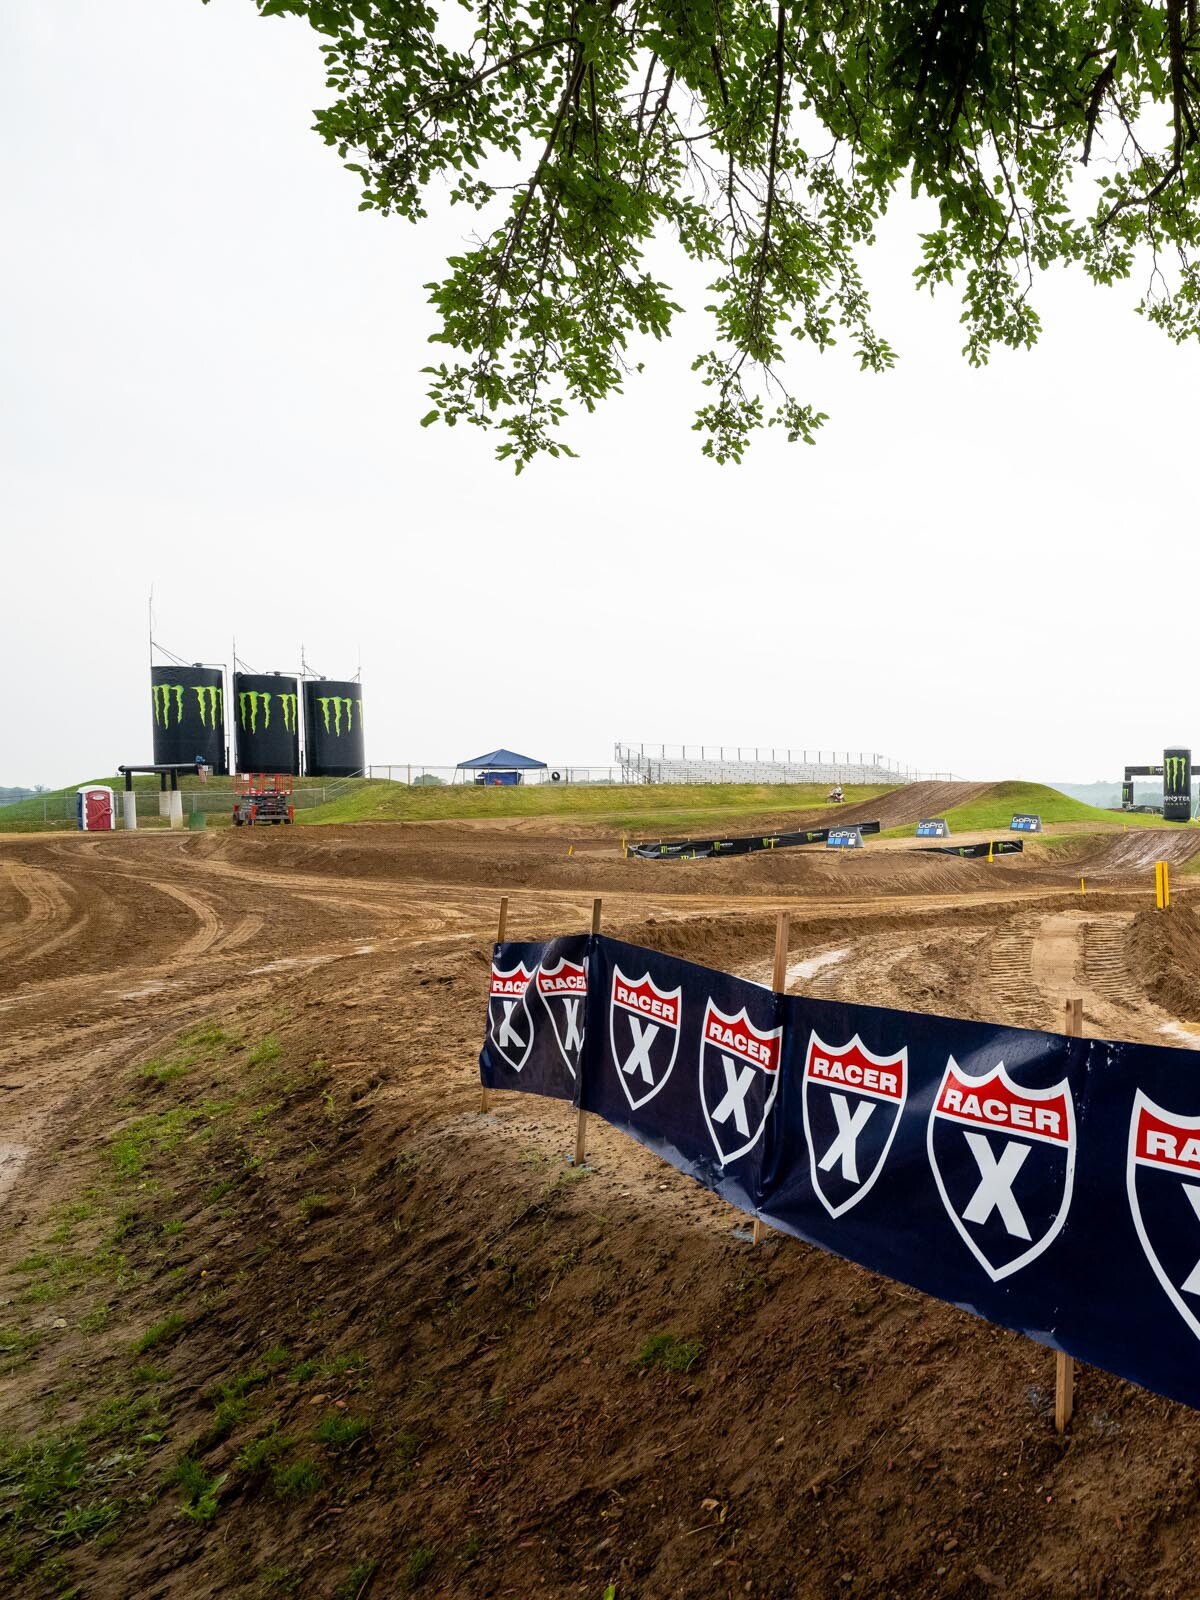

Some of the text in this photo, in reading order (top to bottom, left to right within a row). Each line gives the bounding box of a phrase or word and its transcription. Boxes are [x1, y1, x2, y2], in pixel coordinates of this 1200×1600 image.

[829, 830, 857, 838] GoPro
[1013, 816, 1038, 824] GoPro
[493, 980, 529, 993] RACE
[541, 976, 587, 991] RACE
[617, 986, 675, 1022] RACER
[622, 1014, 660, 1087] X
[709, 1022, 772, 1066] RACER
[813, 1057, 898, 1094] RACER
[711, 1054, 757, 1139] X
[943, 1088, 1061, 1135] RACER
[817, 1092, 877, 1185] X
[961, 1131, 1033, 1242] X
